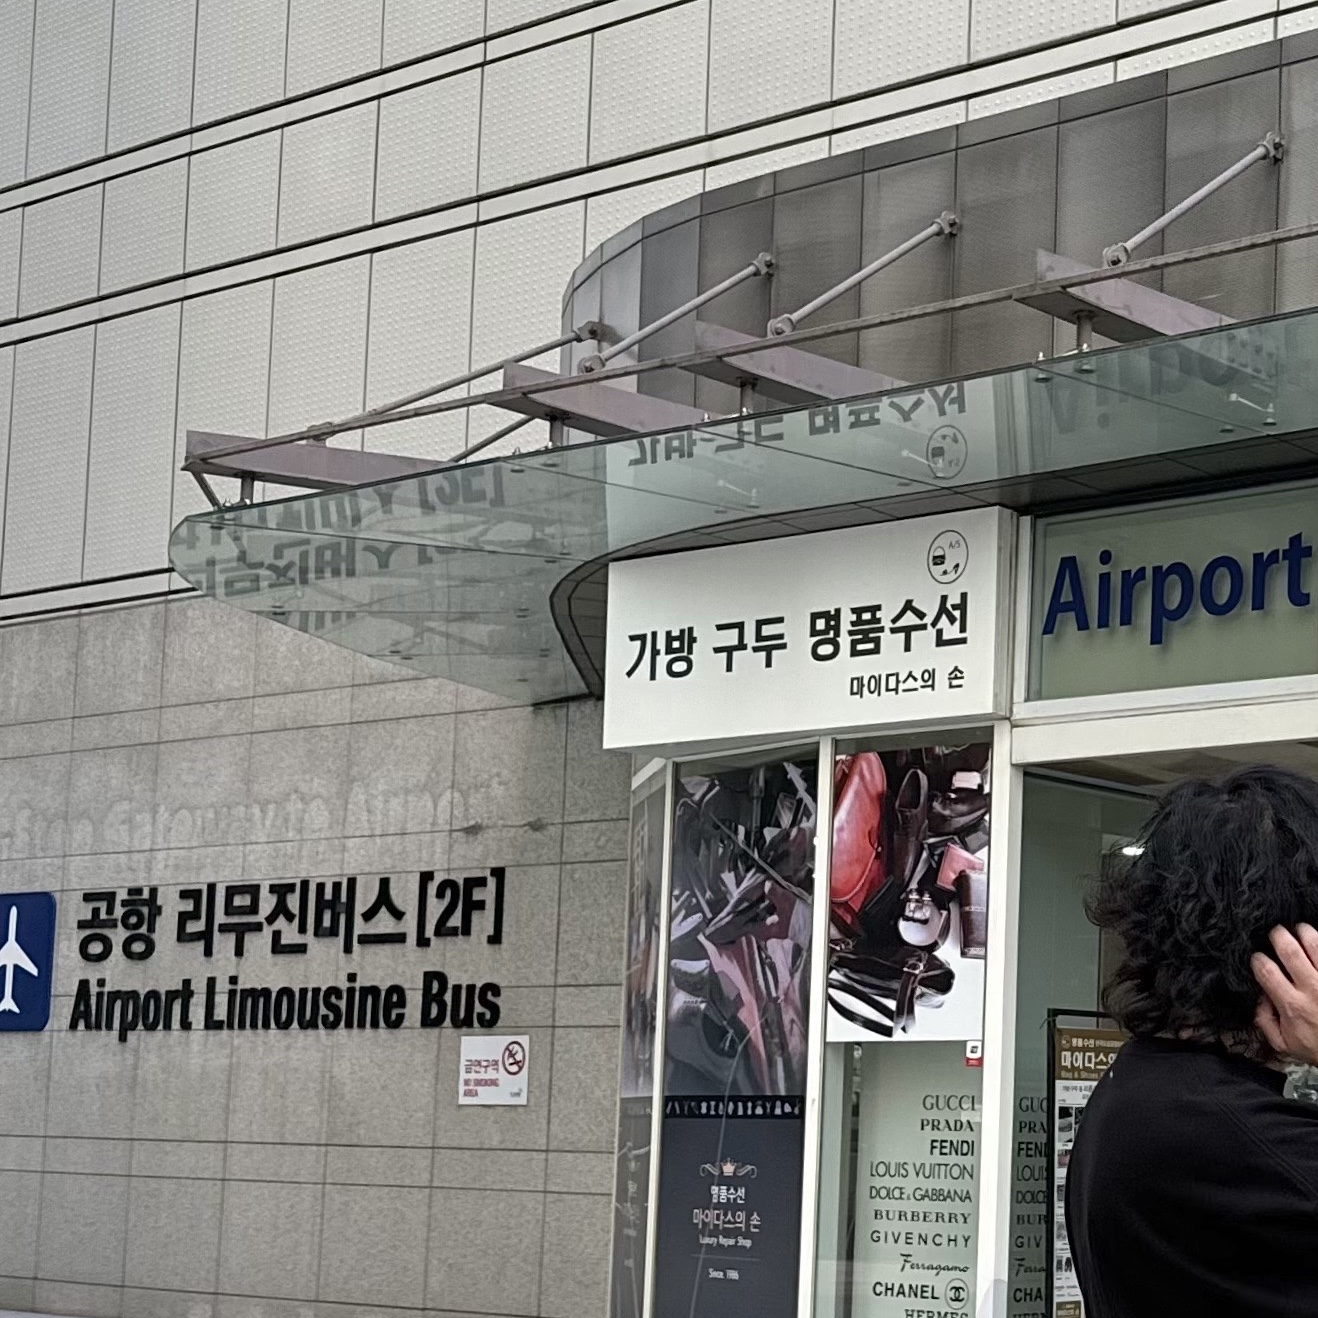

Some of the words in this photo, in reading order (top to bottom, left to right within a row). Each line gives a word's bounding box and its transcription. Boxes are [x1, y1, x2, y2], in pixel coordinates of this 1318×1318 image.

[1042, 532, 1313, 645] Airport
[625, 626, 697, 682] 가방
[712, 616, 787, 673] 구두
[809, 591, 969, 662] 명품수선
[850, 667, 936, 699] 마이다스의
[947, 665, 965, 688] 손
[77, 886, 162, 962] 공항
[69, 977, 194, 1042] Airport
[205, 972, 405, 1031] Limousine
[420, 971, 500, 1028] Bus
[922, 1095, 976, 1111] GUCCI
[920, 1118, 974, 1132] PRADA
[1018, 1120, 1047, 1134] PRA
[930, 1139, 974, 1157] FENDI
[870, 1161, 908, 1178] LOUIS
[913, 1163, 974, 1180] VUITTON
[711, 1185, 745, 1203] 명품수선
[869, 1186, 905, 1201] DOLCE
[912, 1187, 972, 1203] GABBANA
[692, 1208, 746, 1231] 마이다스의
[749, 1211, 761, 1232] 손
[874, 1209, 971, 1224] BURBERRY
[870, 1230, 971, 1248] GIVENCHY
[900, 1253, 969, 1276] Ferragamo
[872, 1281, 940, 1300] CHANEL
